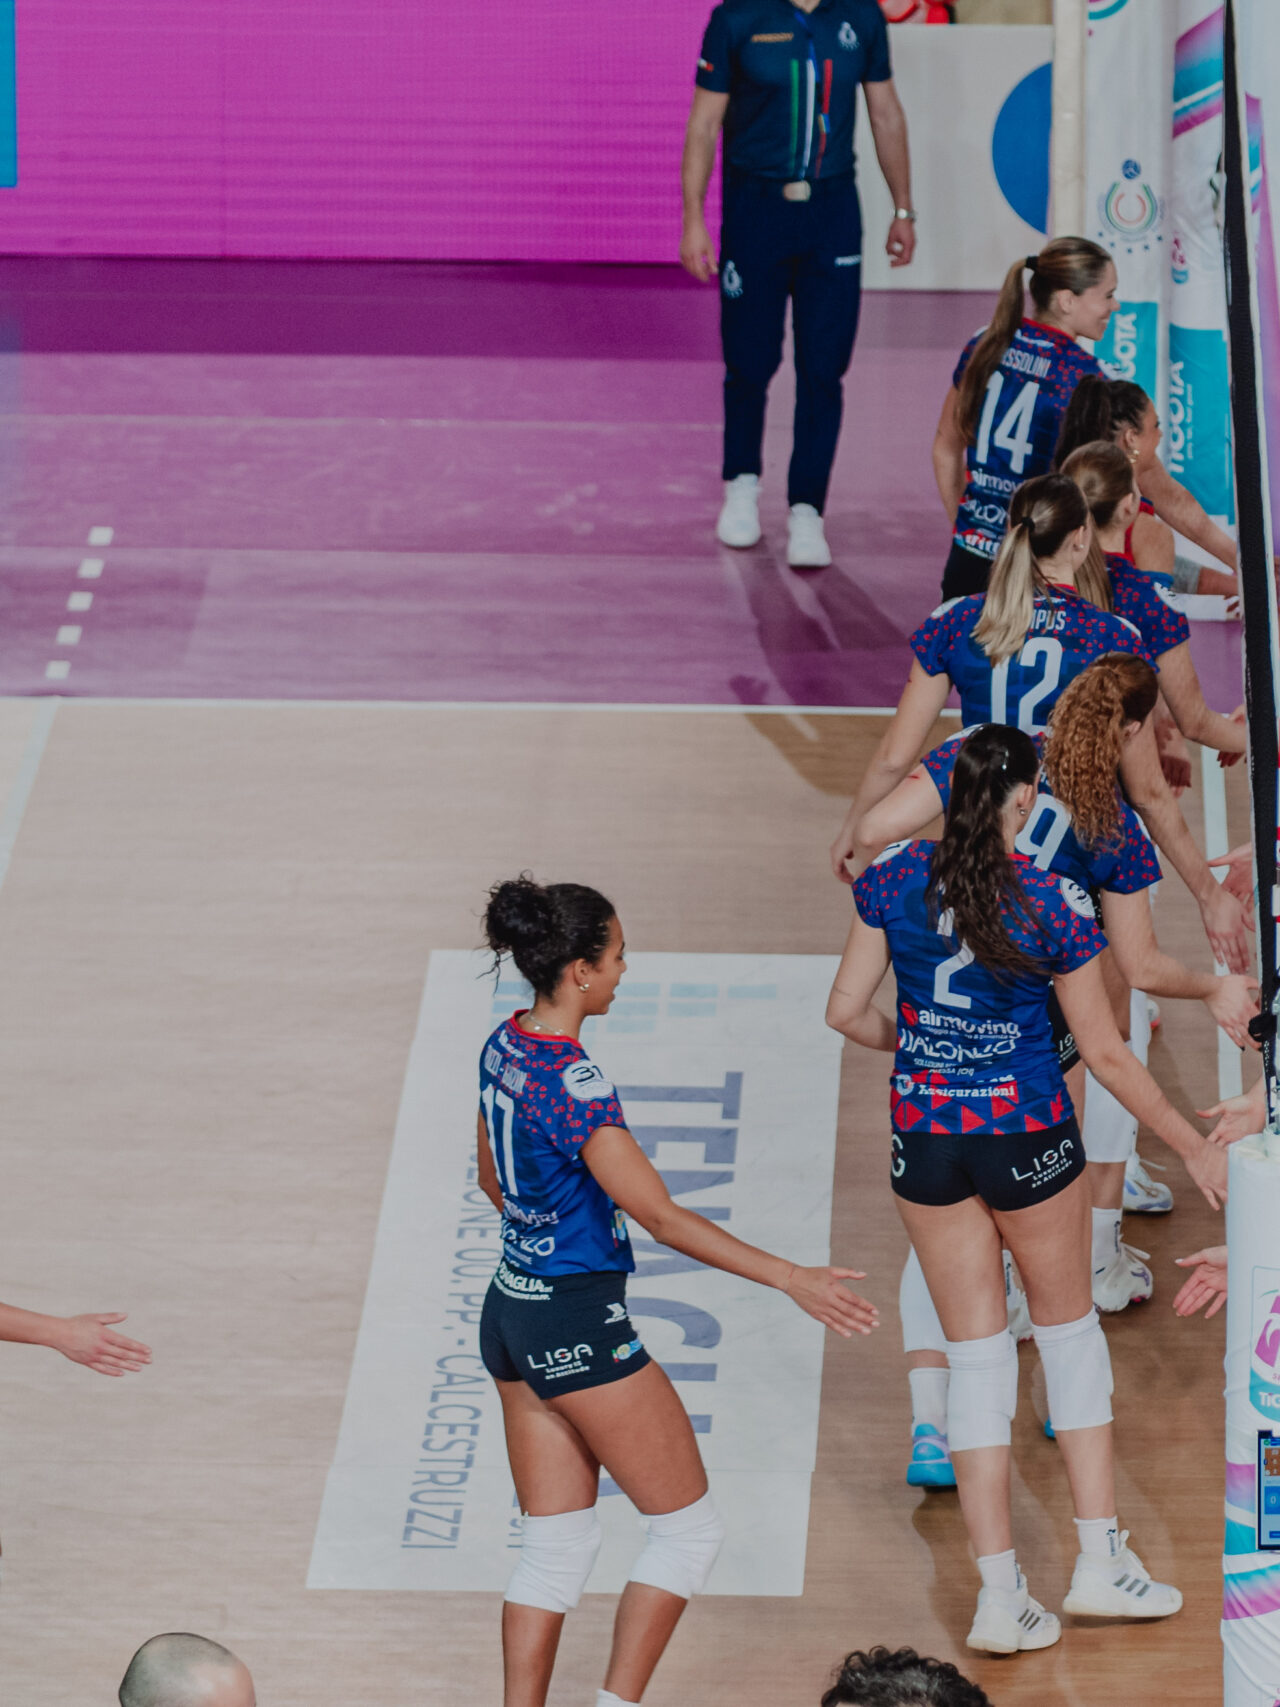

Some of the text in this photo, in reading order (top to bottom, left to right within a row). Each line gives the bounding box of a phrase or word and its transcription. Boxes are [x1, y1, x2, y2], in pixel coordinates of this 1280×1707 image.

[976, 370, 1041, 475] 14
[991, 636, 1063, 735] 12
[1015, 793, 1073, 871] 9
[933, 907, 976, 1010] 2
[481, 1083, 518, 1197] 17
[1010, 1138, 1075, 1181] LISA
[526, 1343, 594, 1369] LISA
[400, 1353, 487, 1550] CALCESTRUZZI
